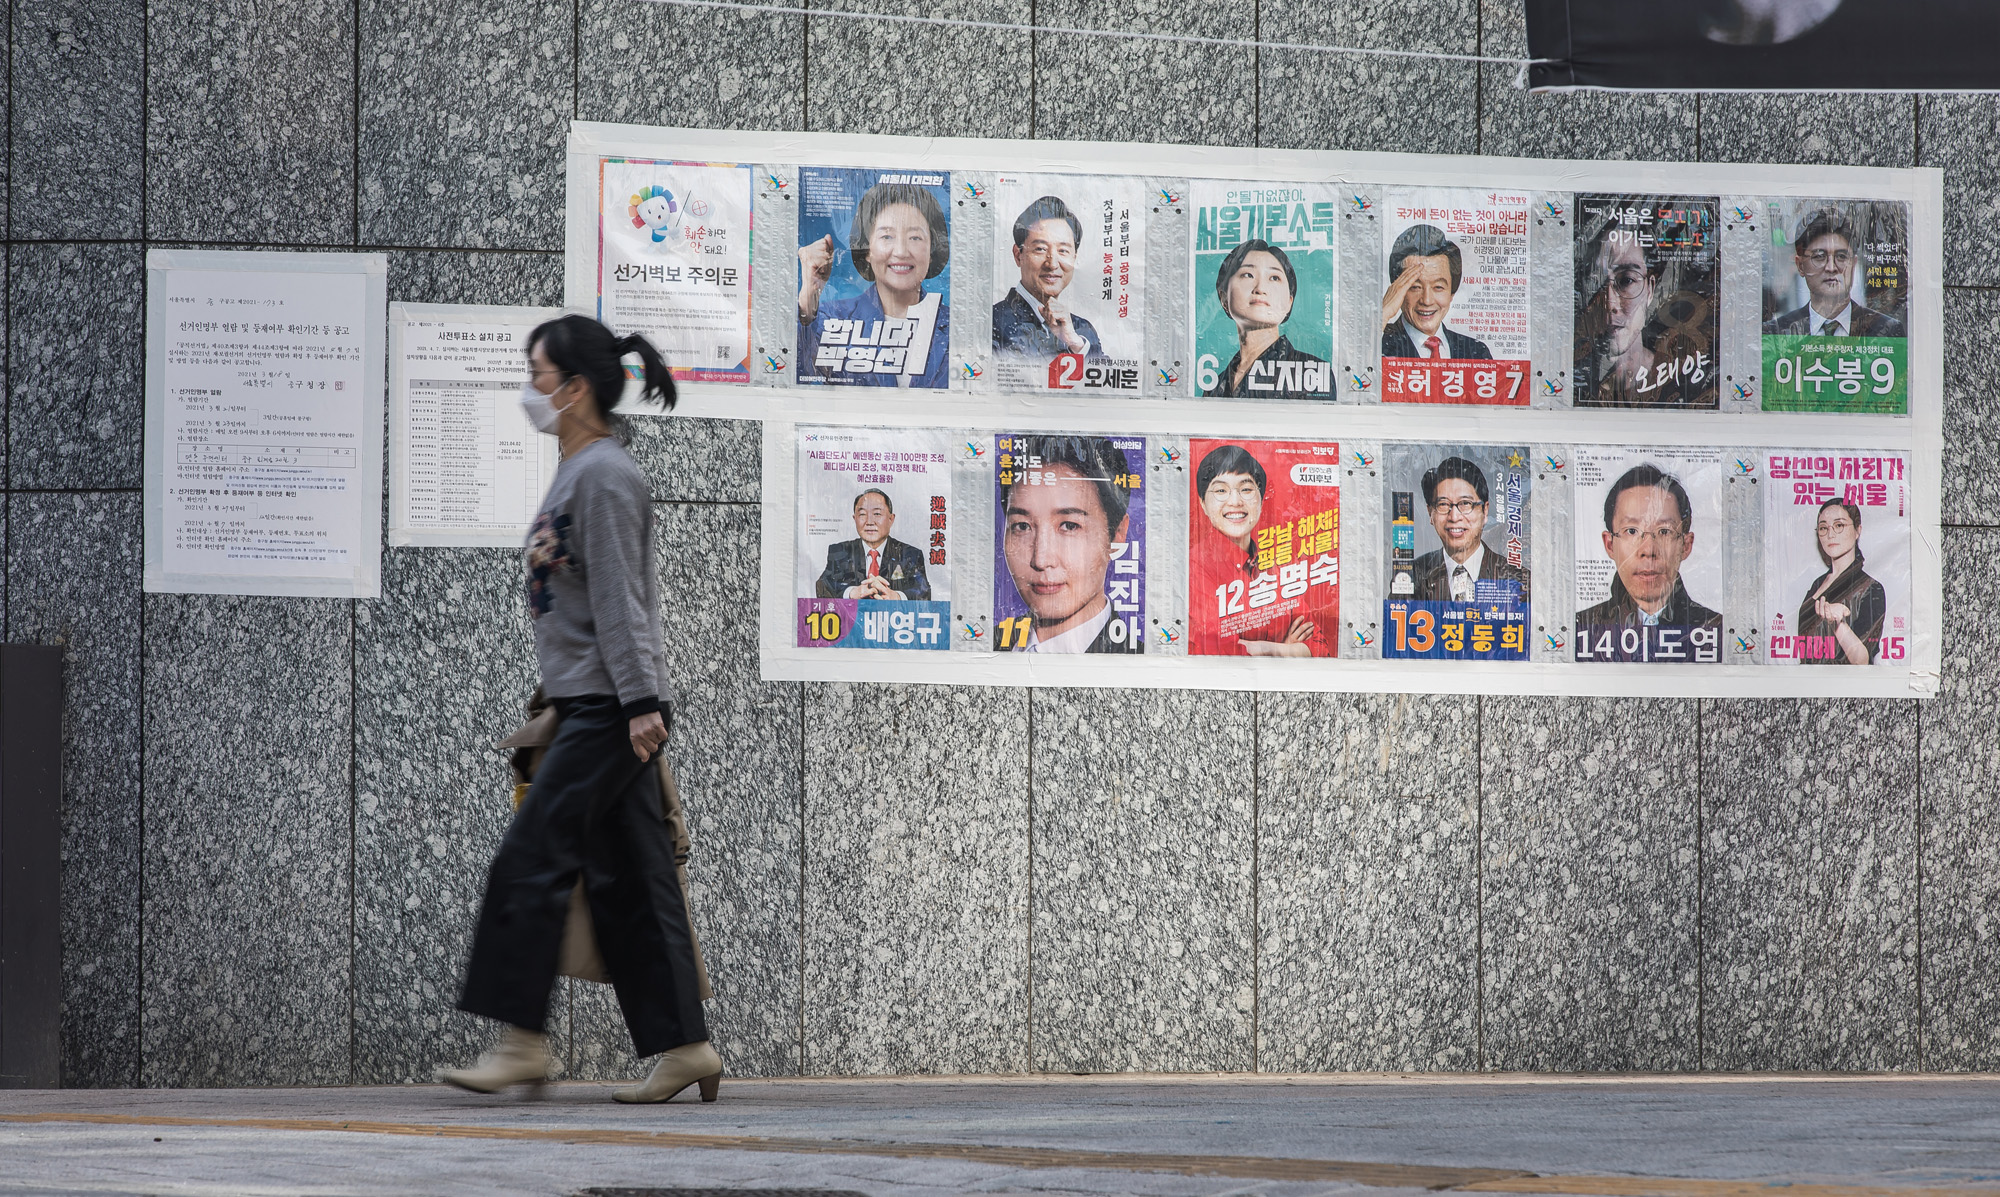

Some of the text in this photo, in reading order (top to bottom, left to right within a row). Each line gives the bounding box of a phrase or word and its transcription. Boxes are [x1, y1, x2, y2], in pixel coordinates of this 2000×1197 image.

[878, 174, 944, 186] 서울시 대전환
[1227, 188, 1306, 204] 안될거없잖아.
[1498, 196, 1527, 204] 국가혁명당
[1396, 208, 1528, 223] 국가에 돈이 없는 것이 아니라
[1608, 207, 1654, 225] 서울은
[684, 225, 726, 240] 훼손하면
[1119, 209, 1130, 257] 서울부터
[1196, 202, 1334, 251] 서울기본소득
[1447, 222, 1527, 236] 도둑놈이 많습니다
[1460, 235, 1527, 246] 국가 미래를 내다보는
[1609, 230, 1654, 248] 이기는
[690, 241, 727, 256] 안 돼요!
[1102, 199, 1113, 301] 첫날부터 능숙하게
[1474, 246, 1527, 256] 허경영이 옳았다!
[1478, 256, 1485, 264] 그
[1487, 256, 1508, 265] 나물에
[1510, 256, 1518, 264] 그
[613, 263, 739, 287] 선거벽보 주의문
[1480, 265, 1527, 275] 이제 끝냅시다.
[1867, 267, 1898, 276] 서민 행복
[1463, 276, 1482, 285] 서울시
[1483, 277, 1496, 285] 예산
[1867, 278, 1898, 289] 서울 혁명
[179, 321, 350, 336] 선거인명부 열람 및 등재여부 확인기간 등 공고
[437, 331, 512, 342] 사전투표소 설치 공고
[819, 318, 915, 347] 합니다
[906, 292, 943, 376] 1
[1801, 344, 1894, 354] 기본소득 첫 주창자, 제3정치 대표
[815, 346, 909, 375] 박영선
[1087, 358, 1139, 367] 서울특별시장후보
[1060, 355, 1077, 386] 2
[1084, 368, 1139, 389] 오세훈
[1197, 354, 1331, 393] 6 신지혜
[1635, 351, 1711, 394] 오태양
[1775, 356, 1895, 395] 이수봉 9
[1505, 371, 1524, 400] 7
[999, 438, 1028, 453] 여자
[1113, 440, 1142, 450] 여성의당
[1312, 446, 1335, 456] 진보당
[853, 451, 882, 461] 에덴동산
[883, 452, 899, 462] 공원
[900, 452, 928, 463] 100만평
[930, 453, 947, 464] 조성,
[999, 455, 1042, 469] 혼자도
[823, 462, 928, 474] 메디컬시티 조성, 복지정책 확대,
[1770, 456, 1905, 481] 당신의 자리가
[857, 474, 894, 484] 예산효율화
[999, 470, 1142, 489] 살기좋은 서울
[1299, 474, 1332, 483] 지지후보
[265, 490, 283, 498] 인터넷
[1507, 473, 1521, 504] 서울
[1793, 482, 1836, 506] 있는
[1843, 483, 1887, 506] 서울
[1496, 472, 1505, 523] 3시 정동희
[1257, 507, 1339, 550] 강남 해체!
[1257, 528, 1338, 571] 평등 서울!
[1215, 552, 1339, 618] 12 송명숙
[1108, 540, 1142, 650] 김진아
[813, 602, 836, 612] 기호
[1389, 603, 1408, 611] 무소속
[805, 611, 942, 645] 10 배영규
[998, 616, 1032, 648] 11
[1390, 609, 1524, 653] 13 정동희
[1577, 626, 1719, 663] 14 이도엽
[1770, 635, 1905, 660] 신지예 15
